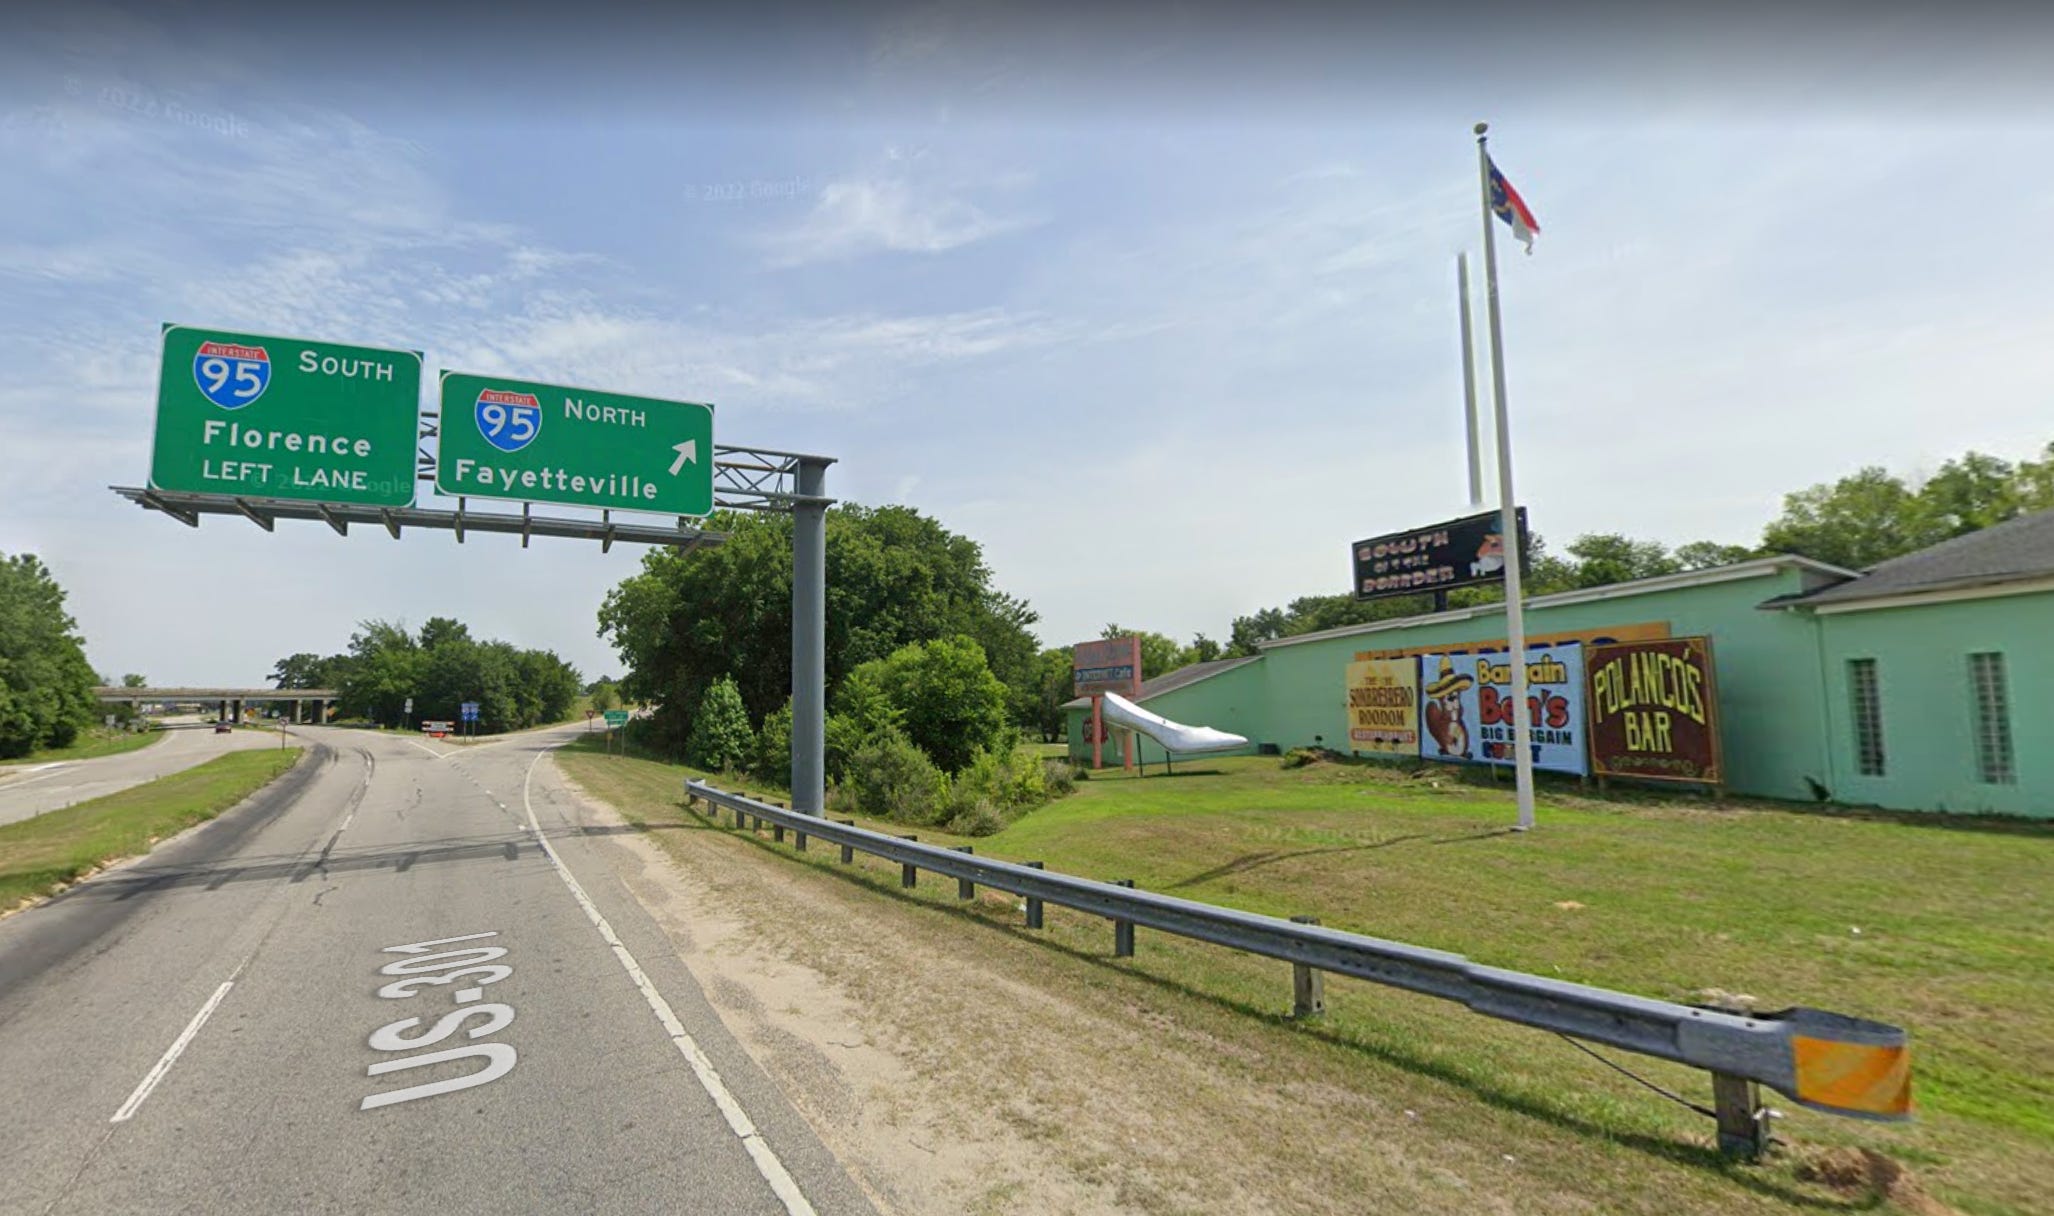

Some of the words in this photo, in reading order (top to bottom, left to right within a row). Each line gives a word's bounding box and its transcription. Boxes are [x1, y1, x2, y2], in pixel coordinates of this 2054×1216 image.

[202, 358, 262, 398] 95
[203, 419, 372, 457] Florence
[482, 405, 535, 441] 95
[202, 459, 273, 483] LEFT
[293, 466, 368, 491] LANE
[455, 458, 658, 499] Fayetteville
[1481, 726, 1504, 740] BIG
[1624, 711, 1673, 753] BAR
